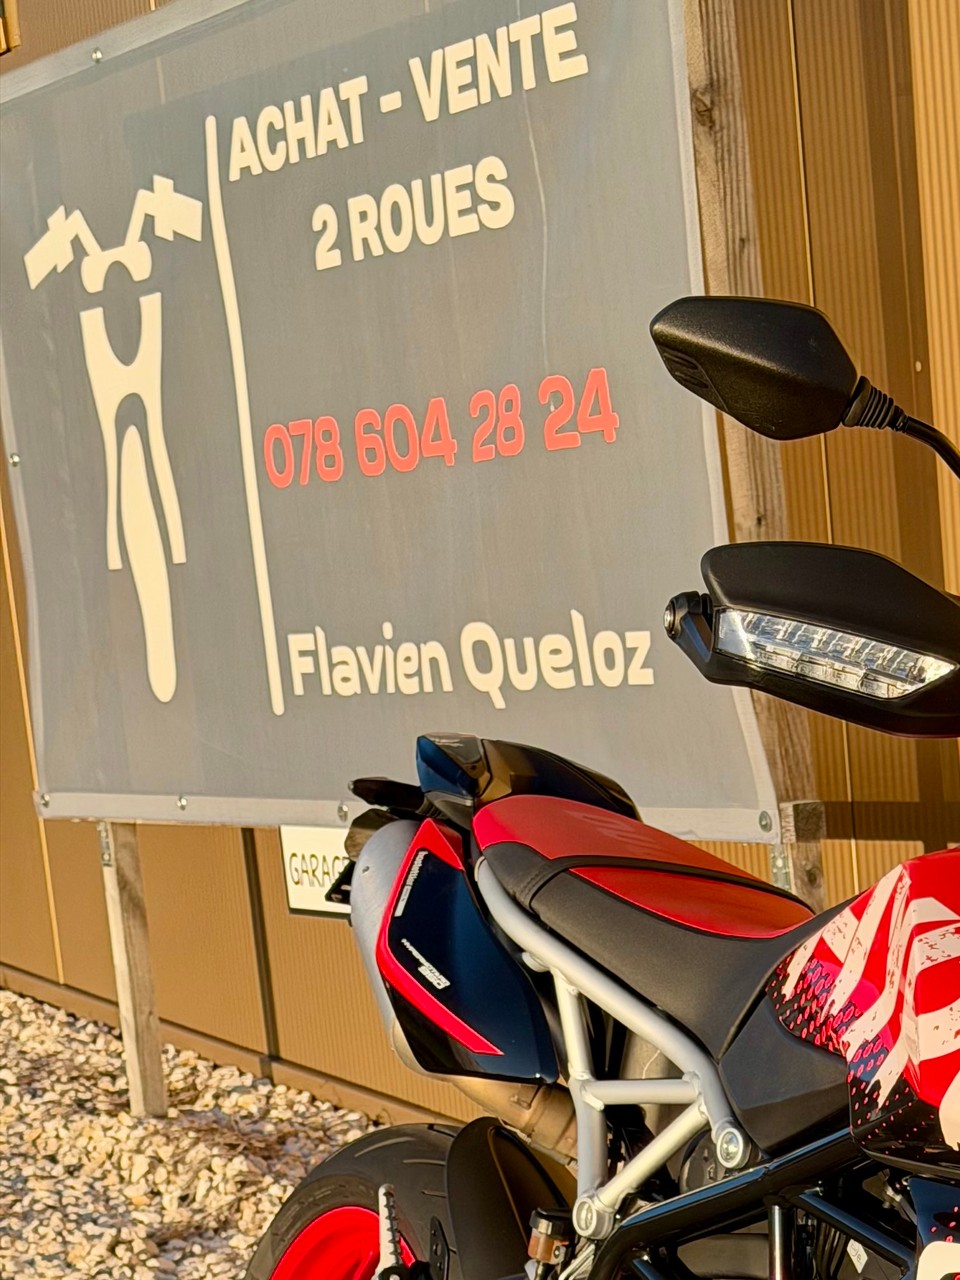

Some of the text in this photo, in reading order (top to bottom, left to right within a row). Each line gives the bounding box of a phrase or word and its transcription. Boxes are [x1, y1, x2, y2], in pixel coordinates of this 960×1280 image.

[230, 3, 589, 182] ACHAT - VENTE
[312, 156, 515, 271] 2 ROUES
[263, 368, 619, 489] 078 604 28 24
[287, 609, 655, 710] Flavien Queloz
